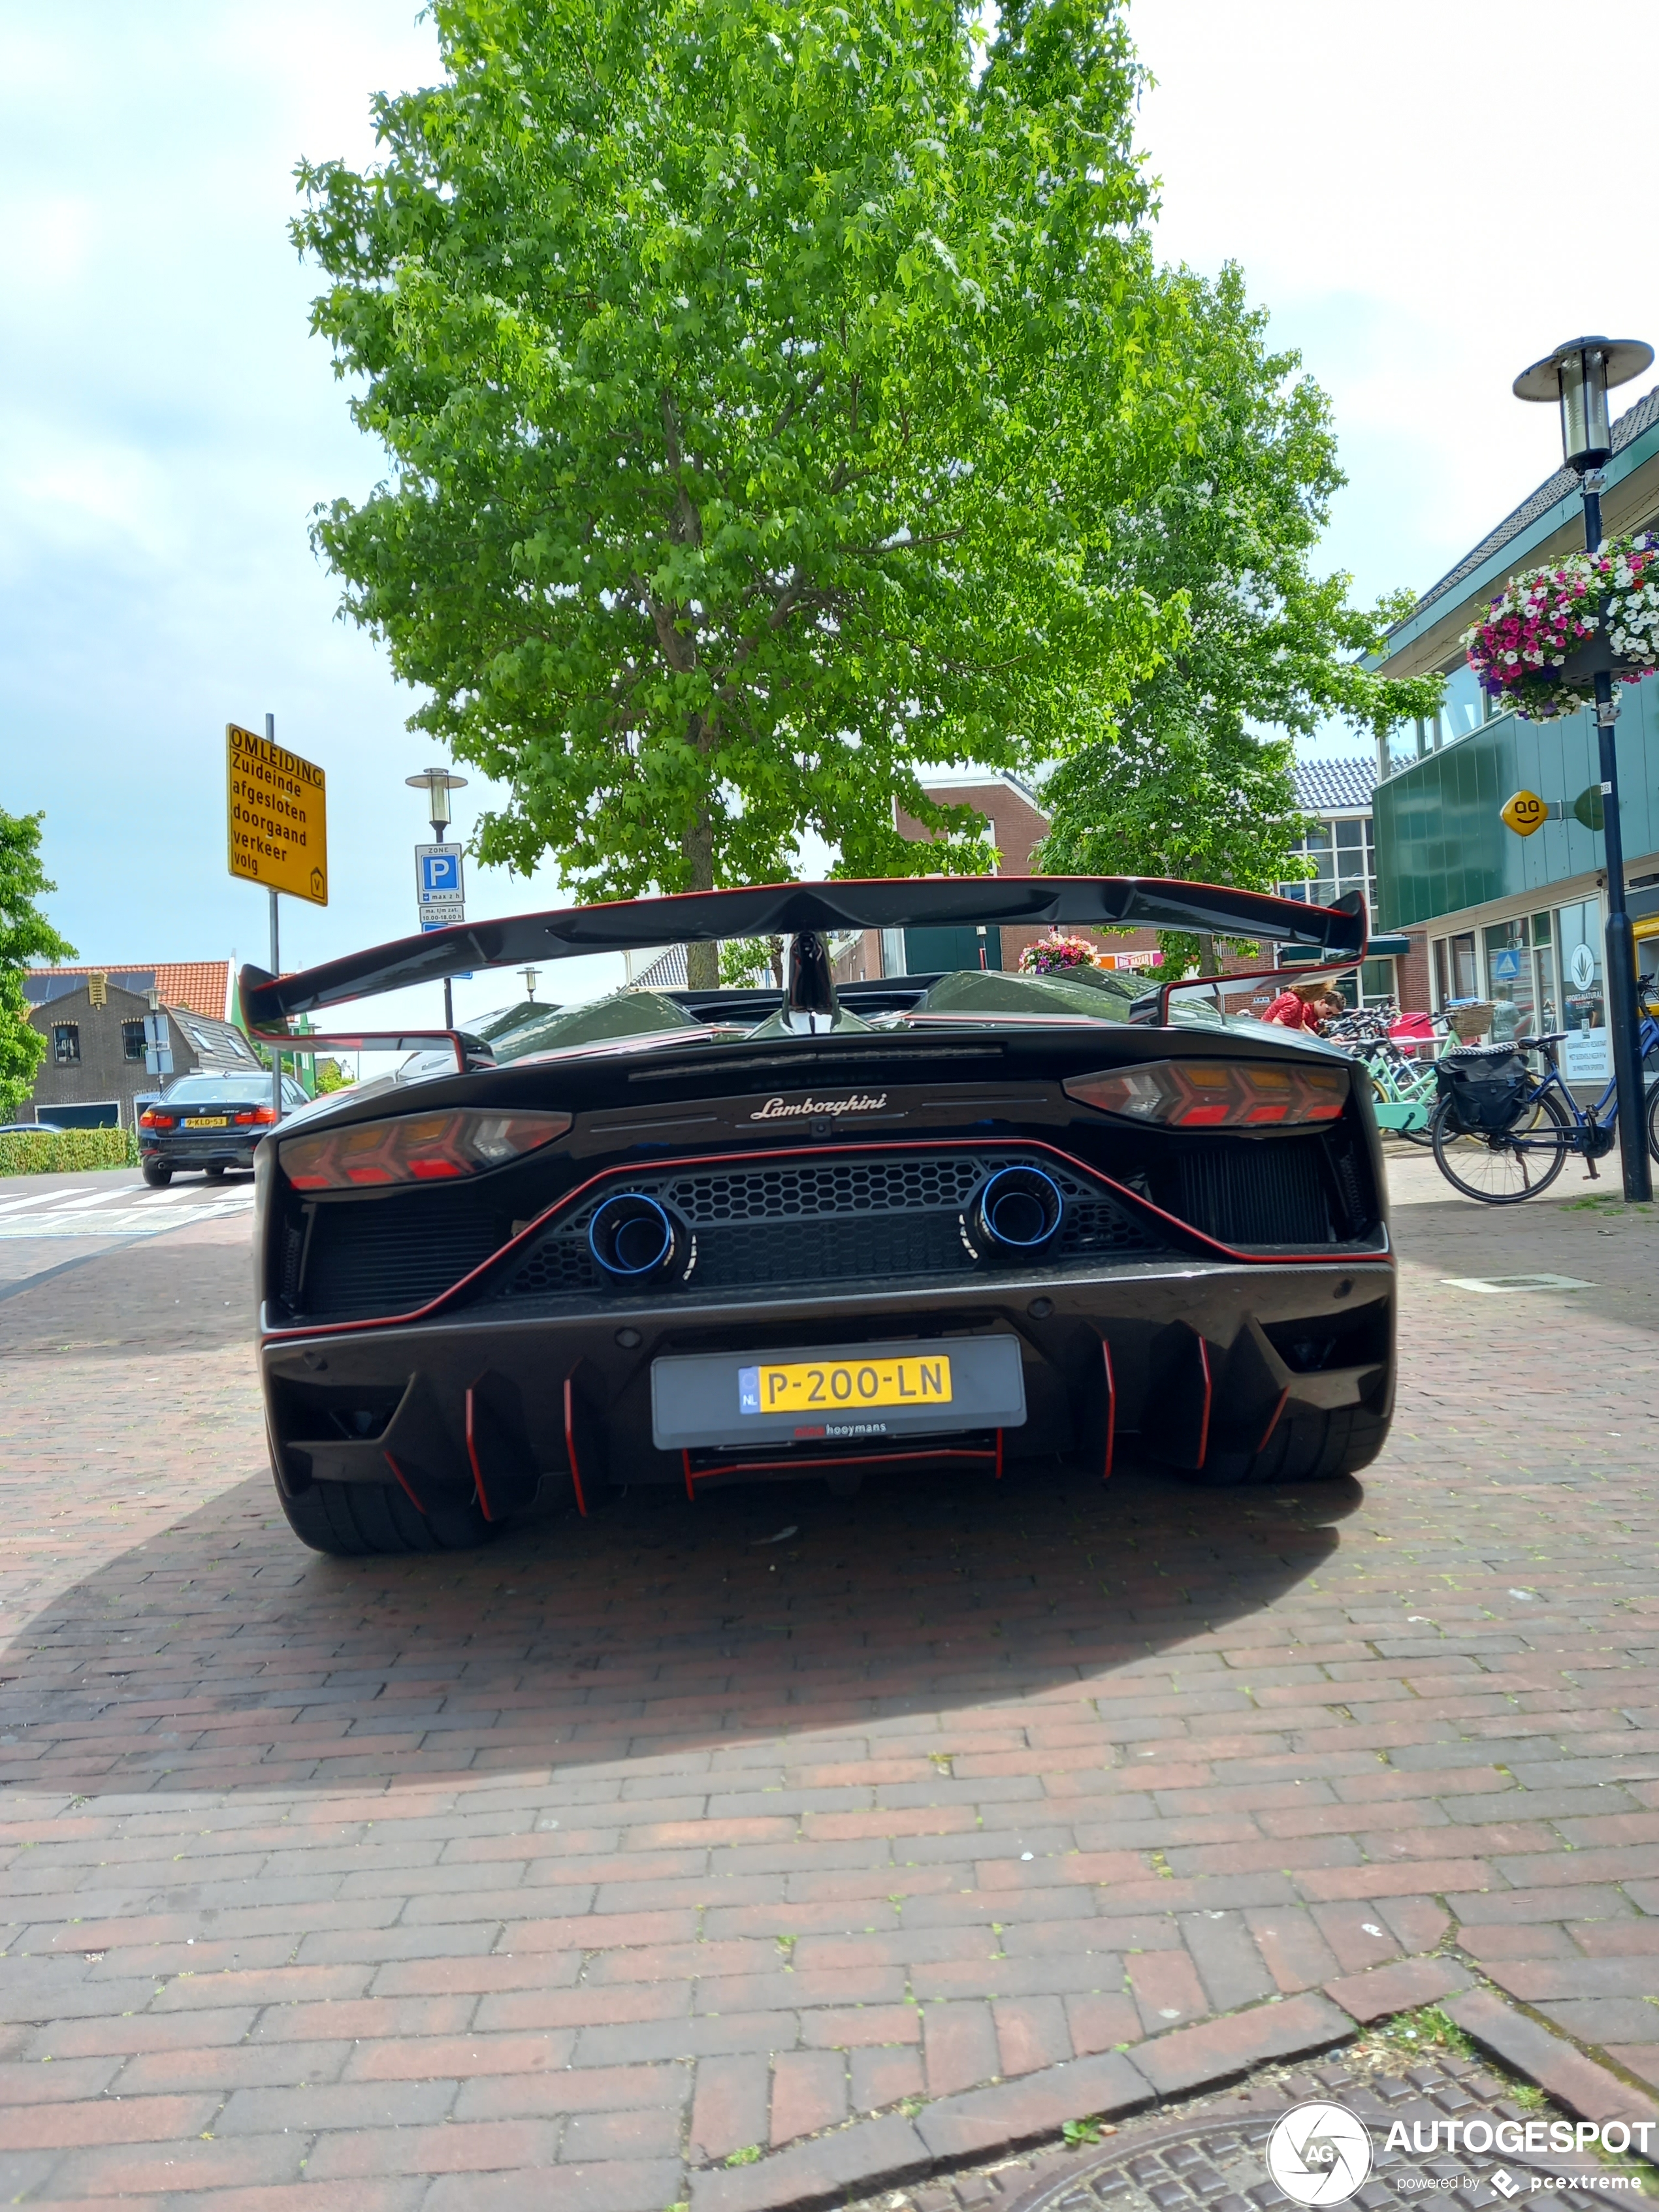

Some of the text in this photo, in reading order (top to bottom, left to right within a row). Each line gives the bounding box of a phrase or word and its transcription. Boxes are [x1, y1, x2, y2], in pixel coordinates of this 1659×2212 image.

[231, 729, 322, 786] OMLEIDING
[232, 751, 301, 797] Zuideinde
[233, 780, 306, 824] afgesloten
[233, 804, 306, 847] doorgaand
[234, 831, 287, 861] verkeer
[234, 851, 258, 875] volg
[430, 859, 449, 887] P
[314, 878, 320, 891] V
[1119, 954, 1150, 967] BIG BAZAR
[750, 1093, 887, 1120] Lamborghini
[768, 1363, 944, 1405] P-200-LN
[743, 1394, 758, 1406] NL
